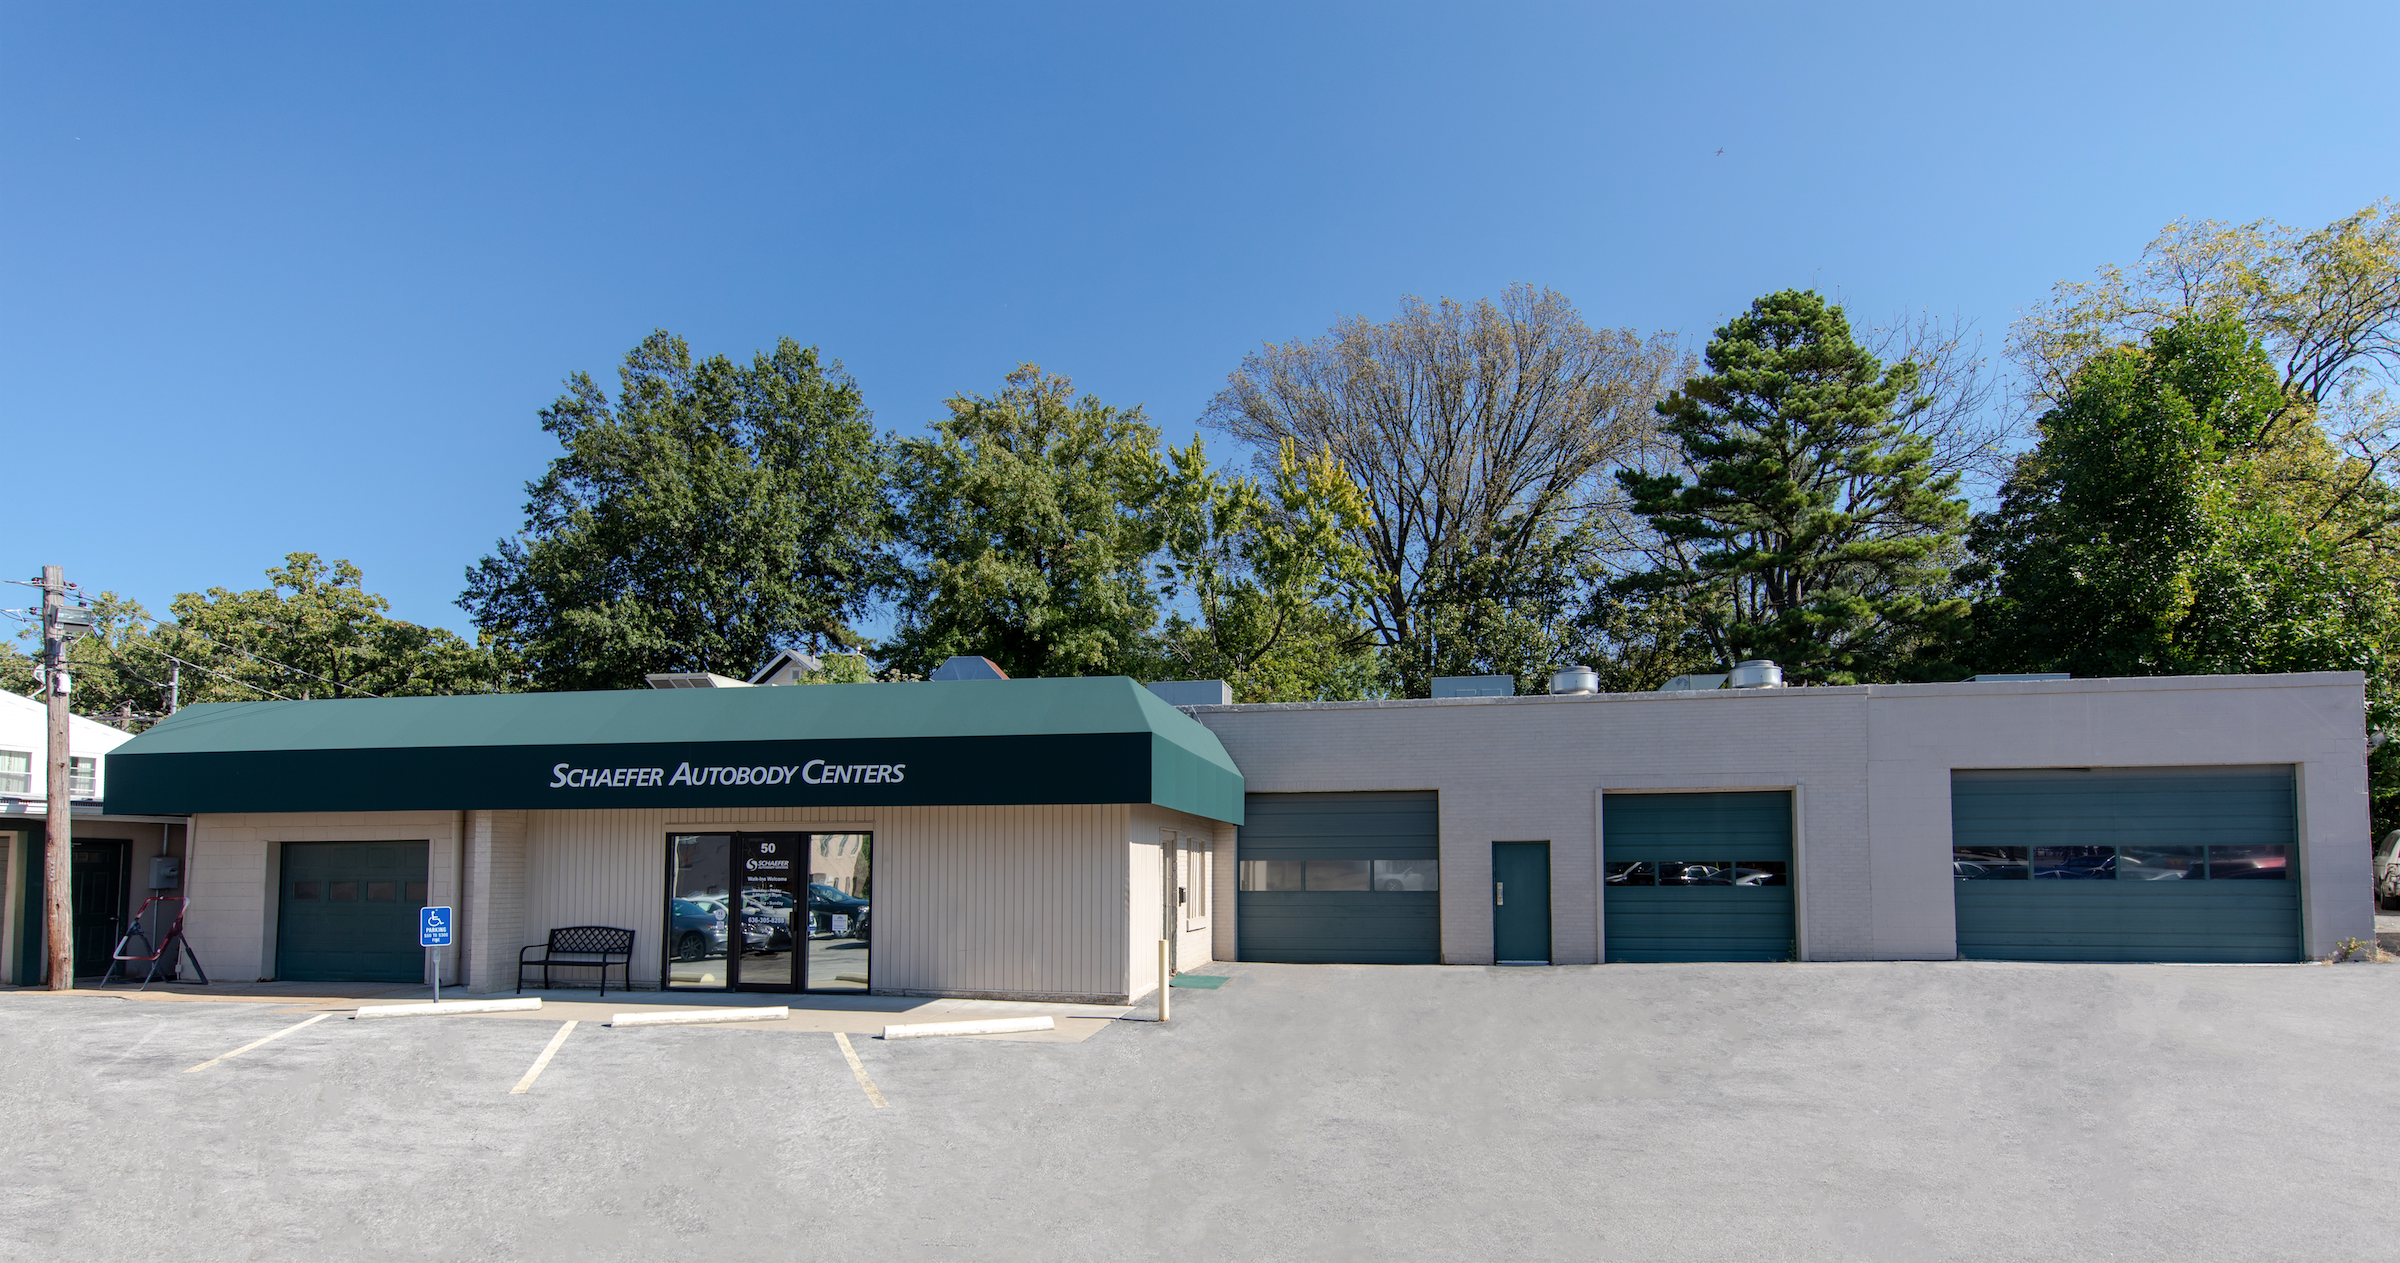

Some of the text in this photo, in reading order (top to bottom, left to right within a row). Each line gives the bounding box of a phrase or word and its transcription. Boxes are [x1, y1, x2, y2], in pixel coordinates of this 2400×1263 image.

[550, 759, 905, 788] SCHAEFER AUTOBODY CENTERS
[760, 843, 776, 854] 50
